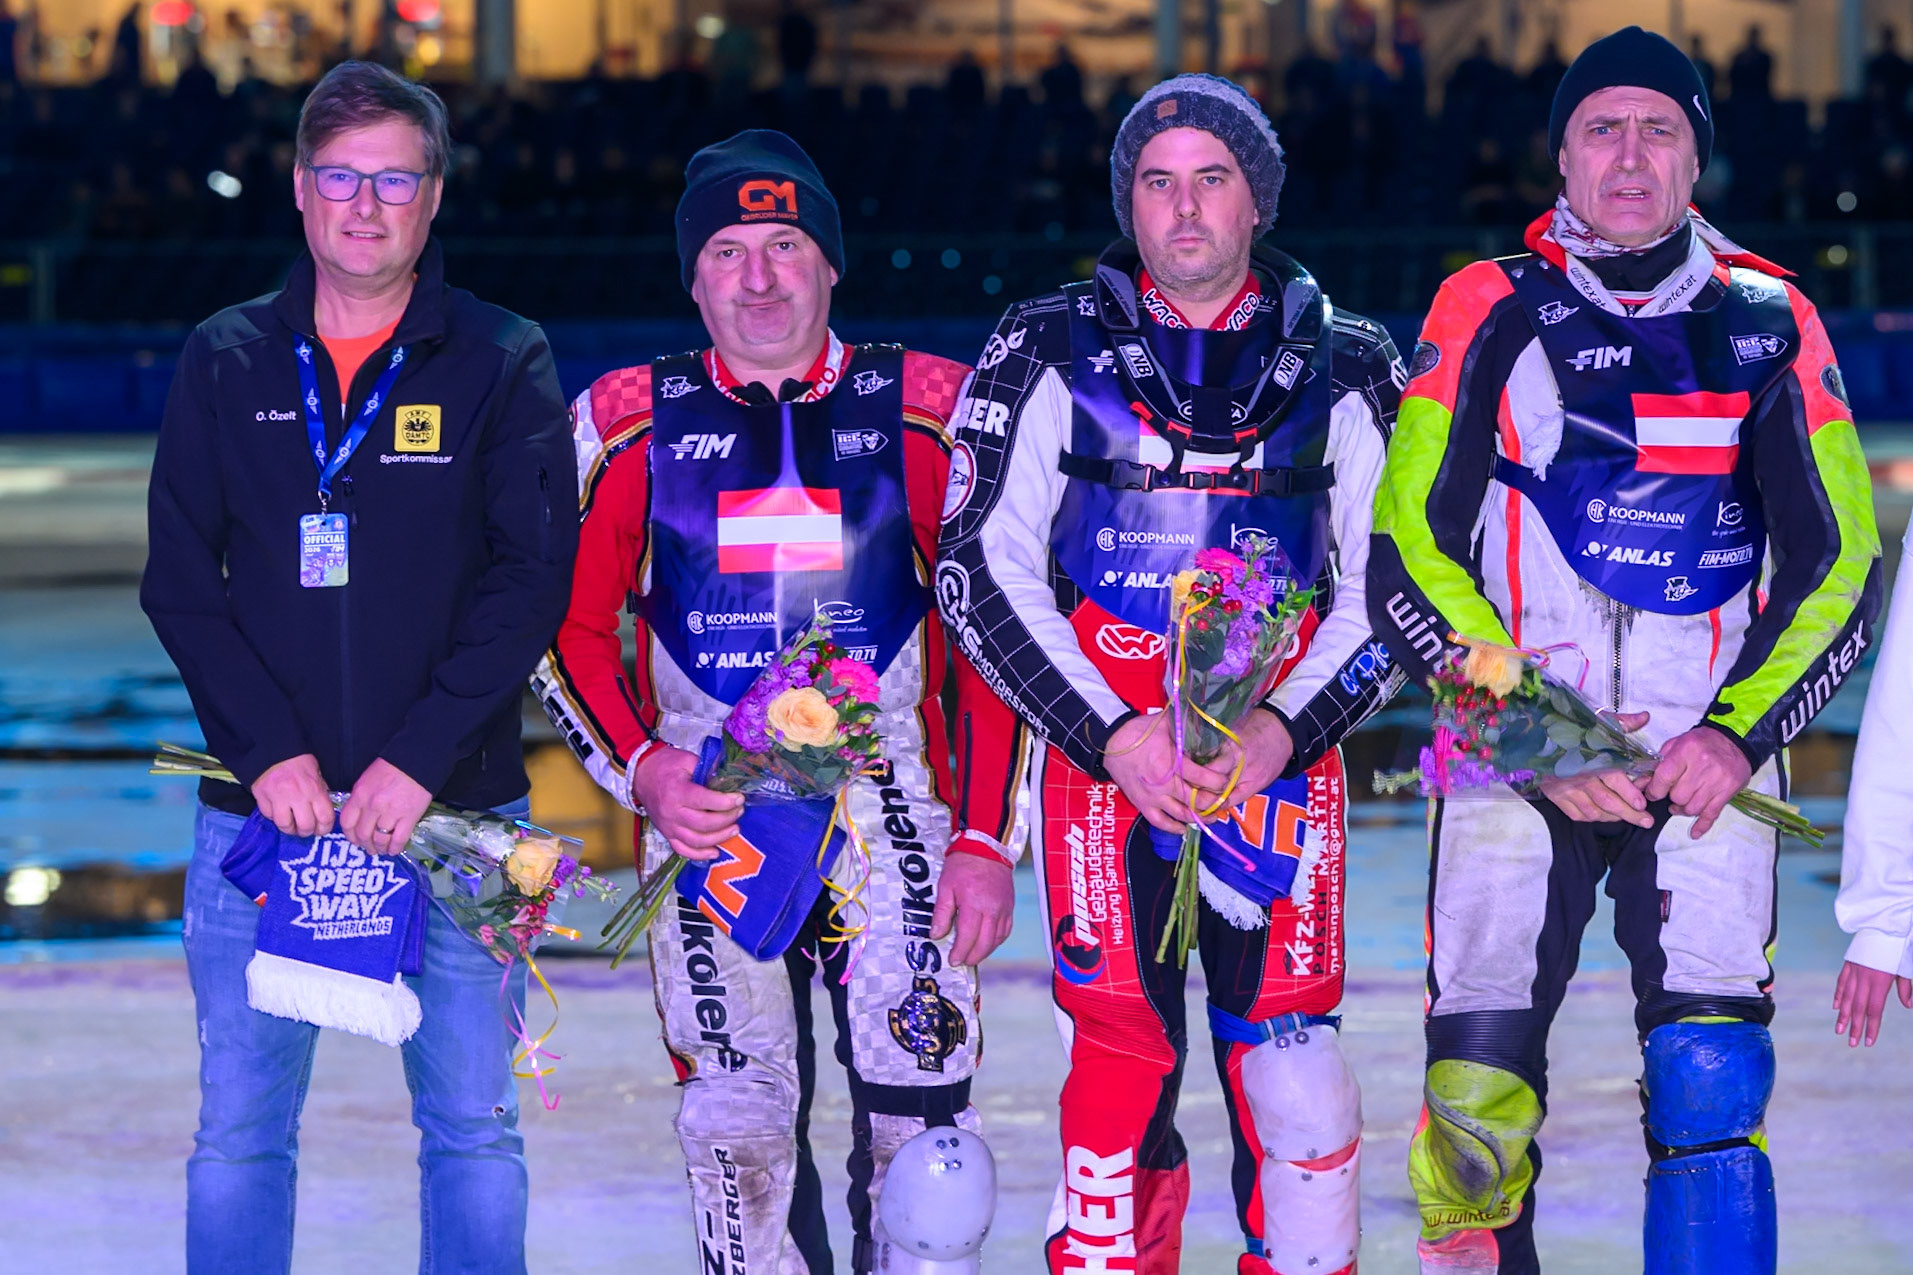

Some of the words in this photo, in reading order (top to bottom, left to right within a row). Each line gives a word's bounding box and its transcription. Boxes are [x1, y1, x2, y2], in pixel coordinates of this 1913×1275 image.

[1658, 274, 1697, 313] wintex.at
[1565, 346, 1632, 371] FIM
[256, 411, 267, 421] O.
[668, 433, 738, 460] FIM
[380, 454, 453, 464] Sportkommissar
[1608, 506, 1686, 525] KOOPMANN
[304, 534, 345, 544] OFFICIAL
[1119, 532, 1195, 544] KOOPMANN
[1606, 547, 1676, 567] ANLAS
[1122, 572, 1172, 588] ANLA
[706, 612, 778, 624] KOOPMANN
[1781, 620, 1867, 743] wintex
[1085, 783, 1107, 922] Gebäudetechnik
[297, 867, 385, 894] SPEED
[309, 893, 380, 920] WAY
[317, 920, 391, 936] NETHERLANDS
[1313, 892, 1327, 975] POSCH
